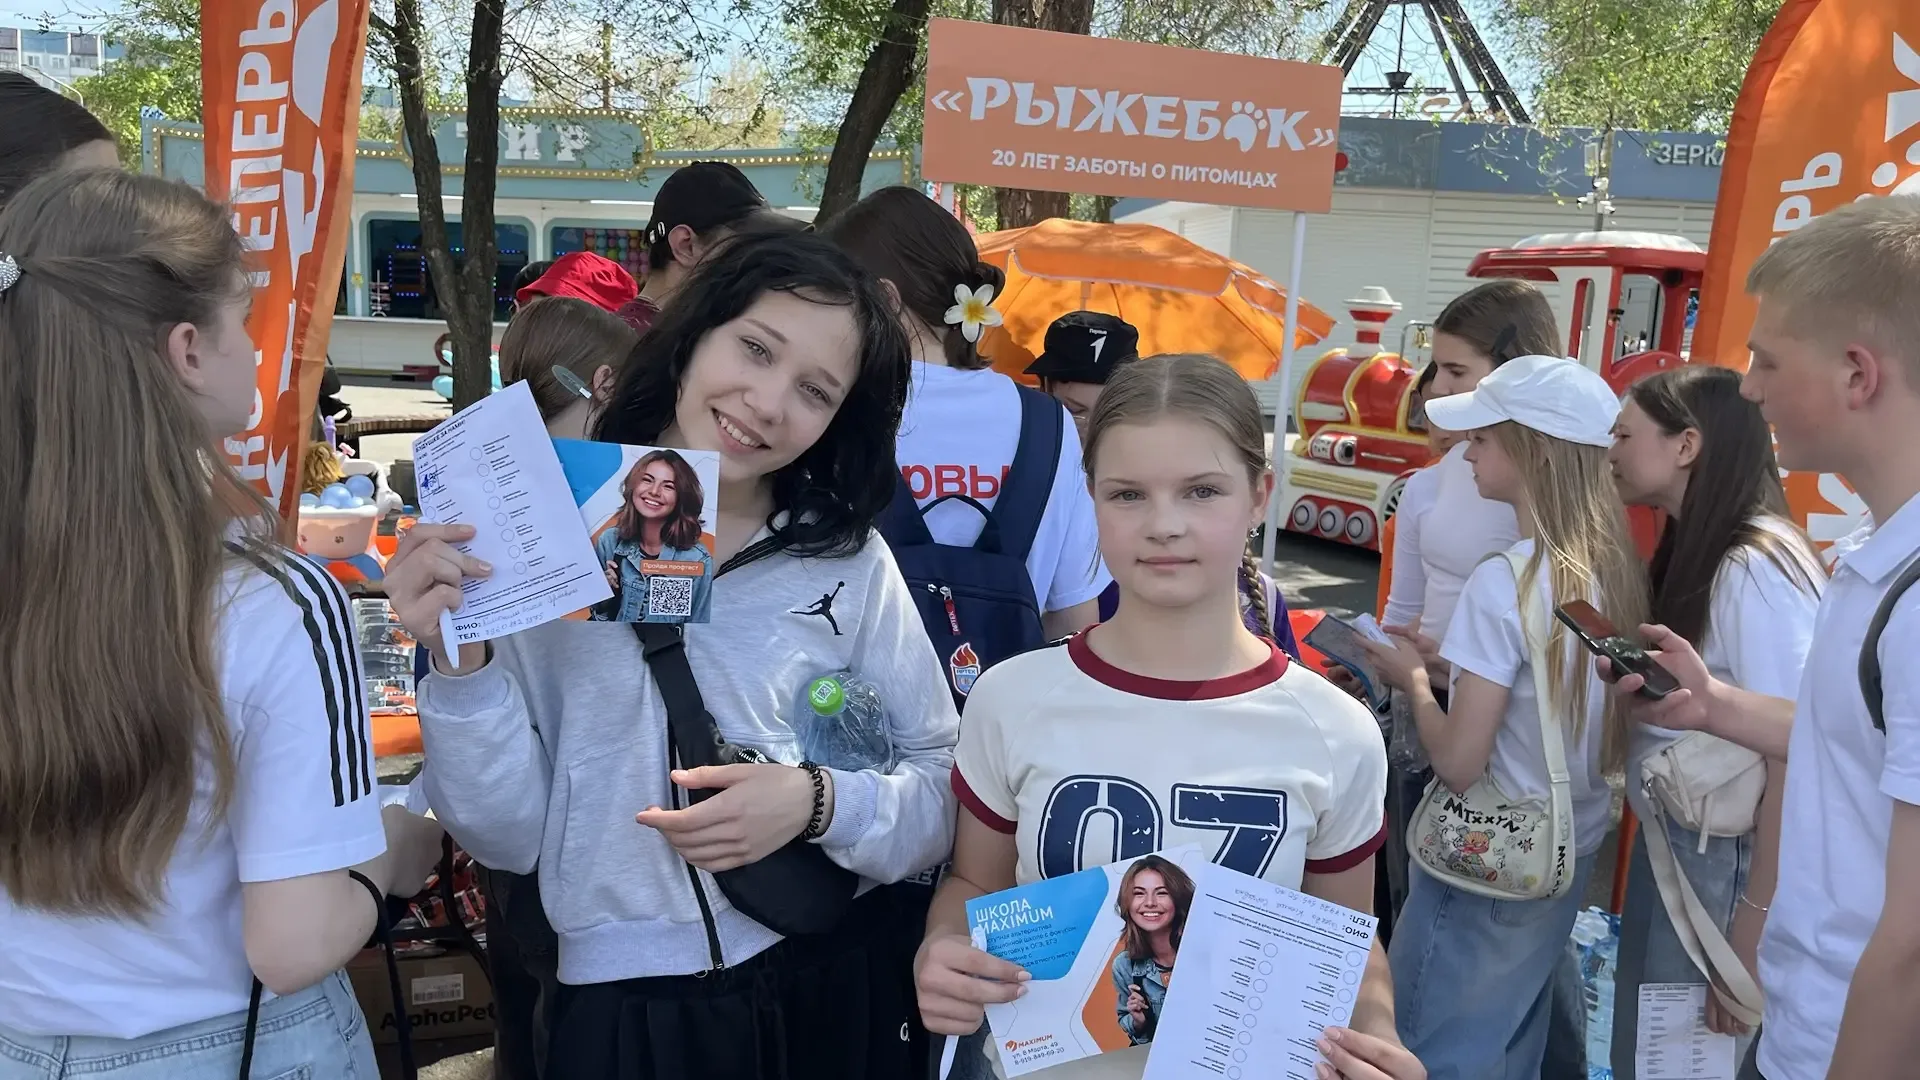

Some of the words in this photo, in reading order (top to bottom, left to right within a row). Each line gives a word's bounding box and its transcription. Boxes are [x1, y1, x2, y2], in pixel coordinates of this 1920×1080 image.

[456, 121, 590, 162] ИР
[992, 149, 1016, 168] 20
[1021, 152, 1060, 171] ЛЕТ
[1064, 156, 1147, 177] ЗАБОТЫ
[1152, 163, 1166, 180] О
[1171, 164, 1277, 189] ПИТОМЦАХ
[642, 562, 668, 570] Пройди
[668, 564, 699, 572] профтест
[455, 621, 482, 632] ФИО:
[457, 631, 480, 641] ТЕЛ:
[1037, 774, 1288, 881] 07
[975, 898, 1032, 923] ШКОЛА
[978, 905, 1054, 935] MAXIMUM
[1349, 914, 1372, 929] ТЕЛ:
[1010, 924, 1052, 939] альтернатива
[1341, 924, 1369, 940] ФИО:
[380, 1002, 497, 1031] AphaPet
[1018, 1034, 1053, 1049] MAXIMUM
